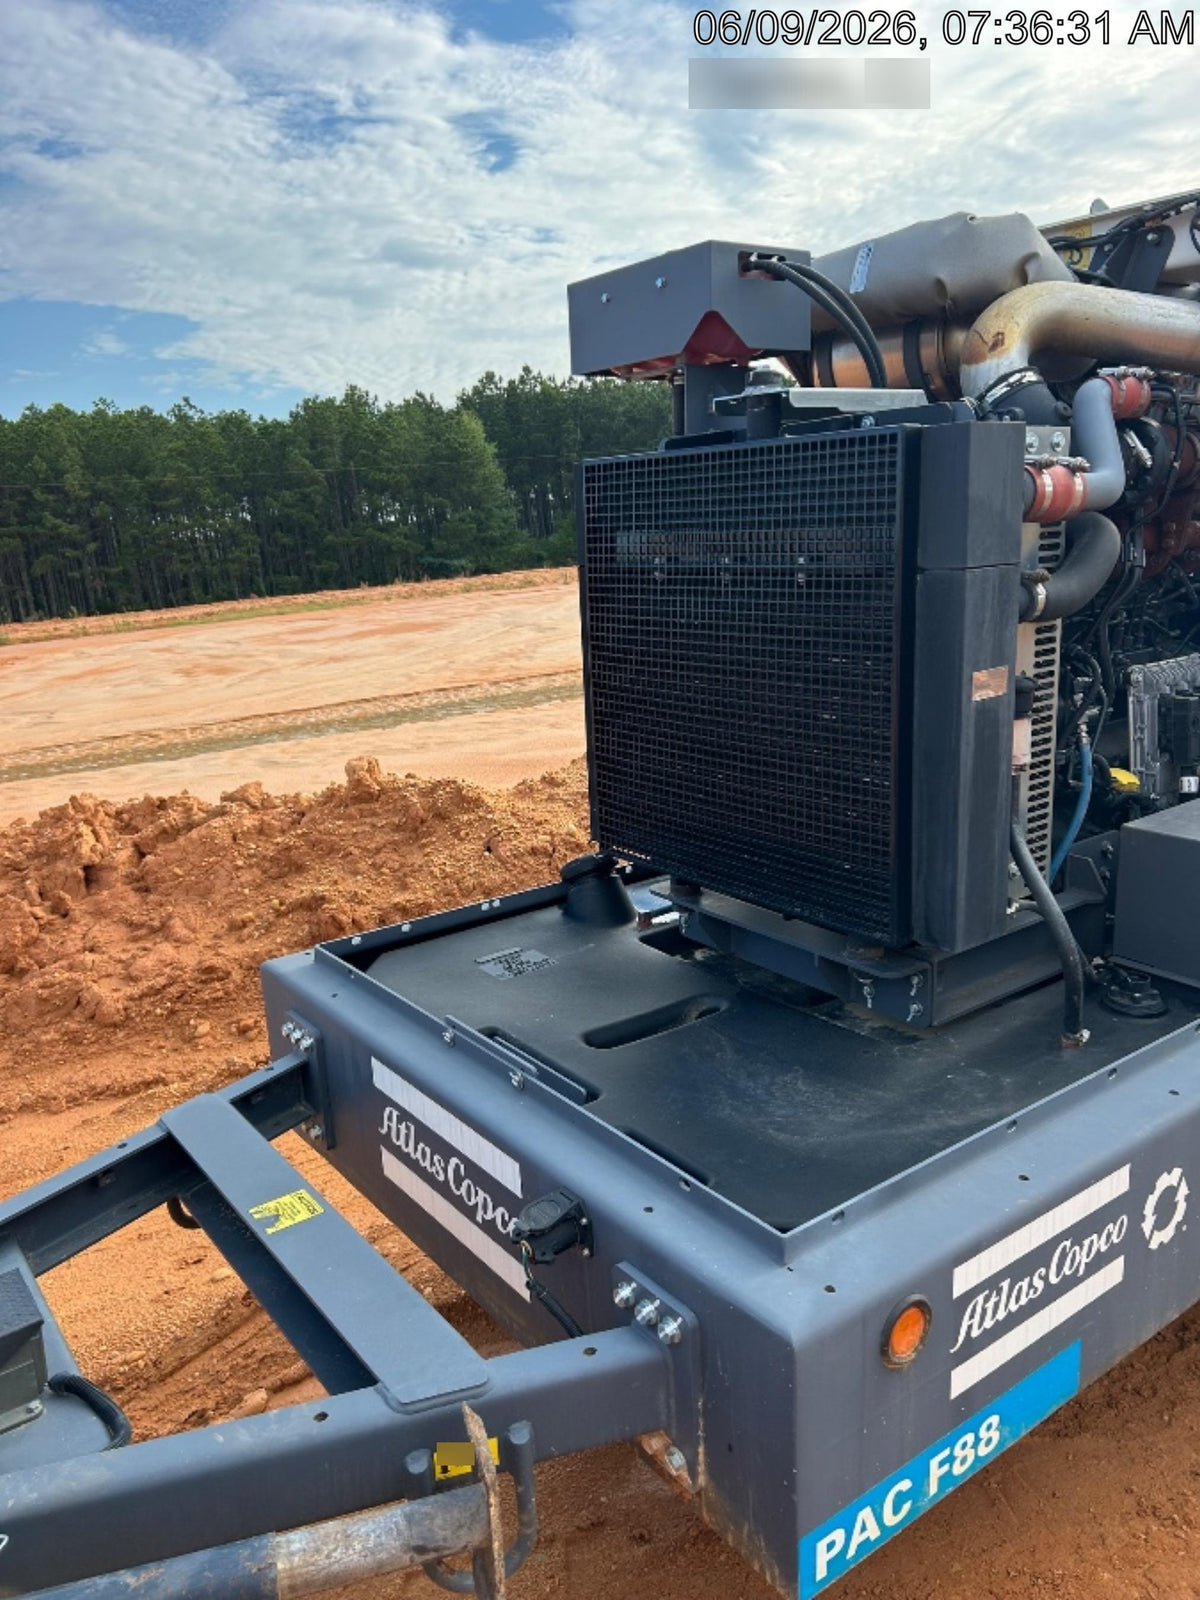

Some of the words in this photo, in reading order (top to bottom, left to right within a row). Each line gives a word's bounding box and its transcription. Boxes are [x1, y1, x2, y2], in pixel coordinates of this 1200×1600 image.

[378, 1106, 446, 1182] Atlas
[949, 1267, 1047, 1353] Atlas
[1048, 1214, 1128, 1285] Copco
[815, 1478, 913, 1583] PAC
[929, 1414, 1001, 1498] F88
